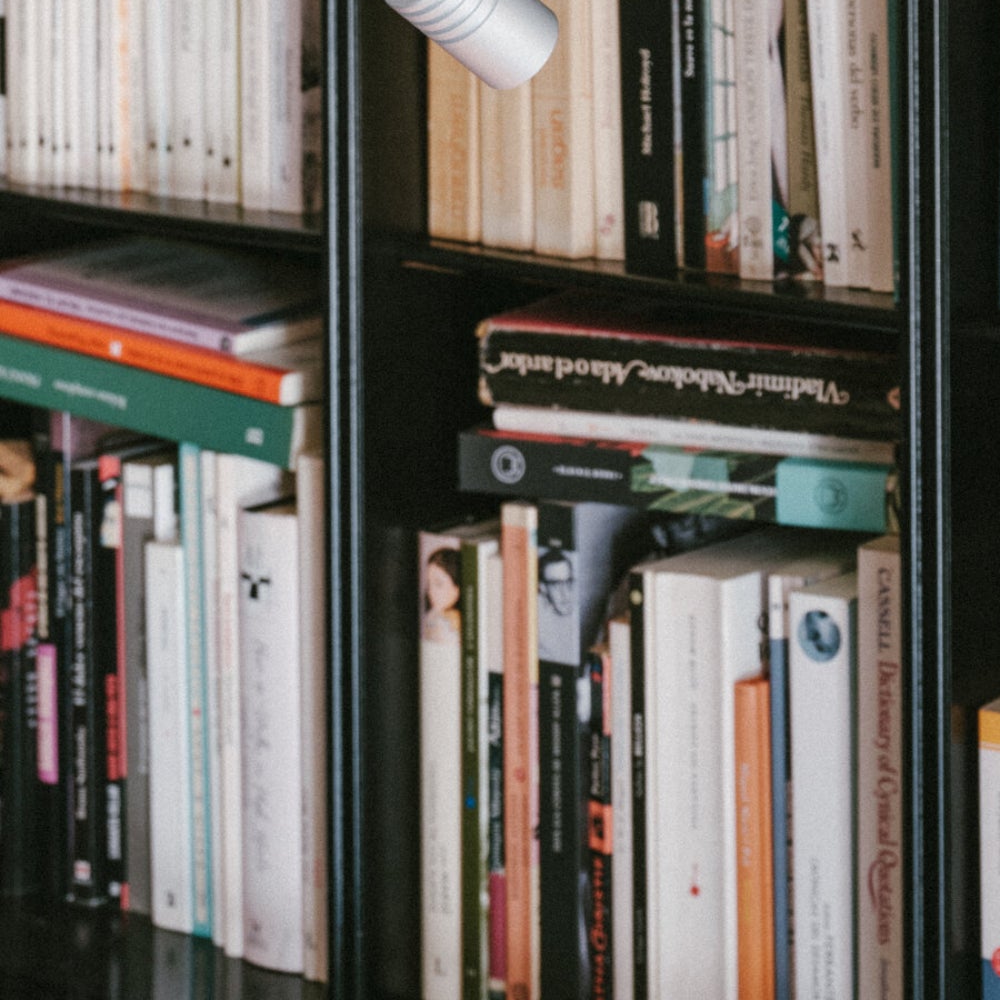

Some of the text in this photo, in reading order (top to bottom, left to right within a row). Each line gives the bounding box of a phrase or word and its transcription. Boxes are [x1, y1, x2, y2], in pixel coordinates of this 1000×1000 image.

[483, 351, 554, 377] ardor
[574, 358, 590, 376] o
[590, 358, 648, 386] Ada
[637, 364, 747, 397] Nabokov
[747, 372, 850, 405] Vladimir
[877, 568, 892, 653] CASSELL
[868, 849, 900, 946] Quotations
